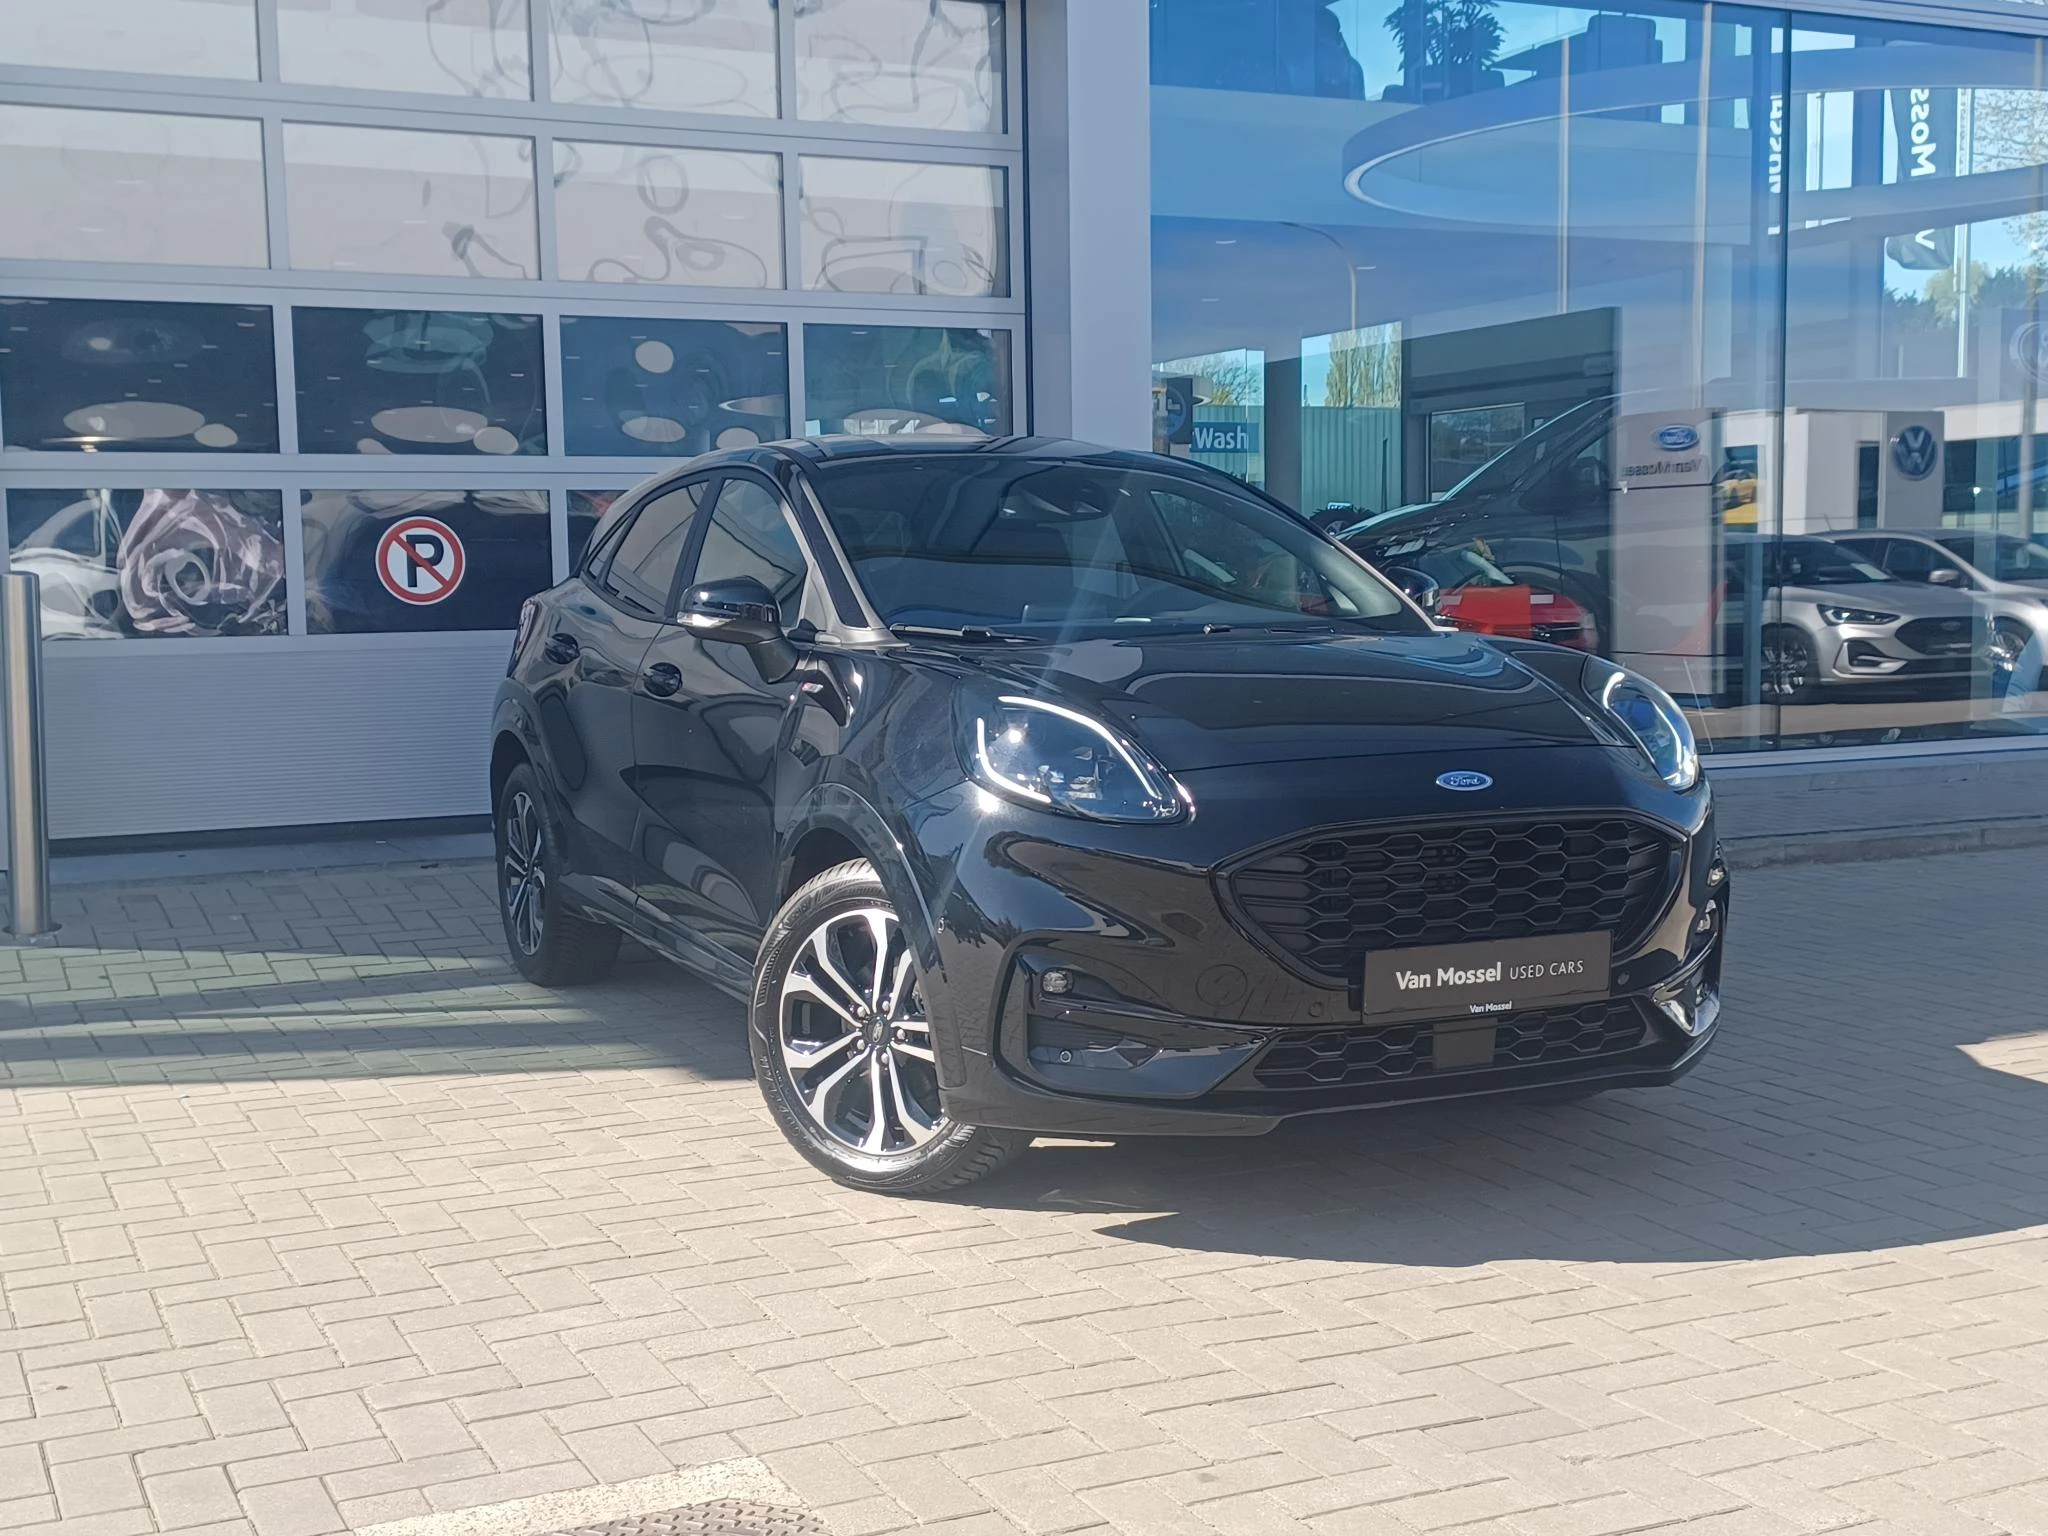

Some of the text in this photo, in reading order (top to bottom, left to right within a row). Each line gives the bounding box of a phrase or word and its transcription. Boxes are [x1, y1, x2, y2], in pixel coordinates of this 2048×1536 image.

[1192, 425, 1250, 449] Wash
[406, 534, 444, 588] P
[1395, 960, 1584, 990] Van Mossel USED CARS
[1470, 1000, 1513, 1013] Van Mossel
